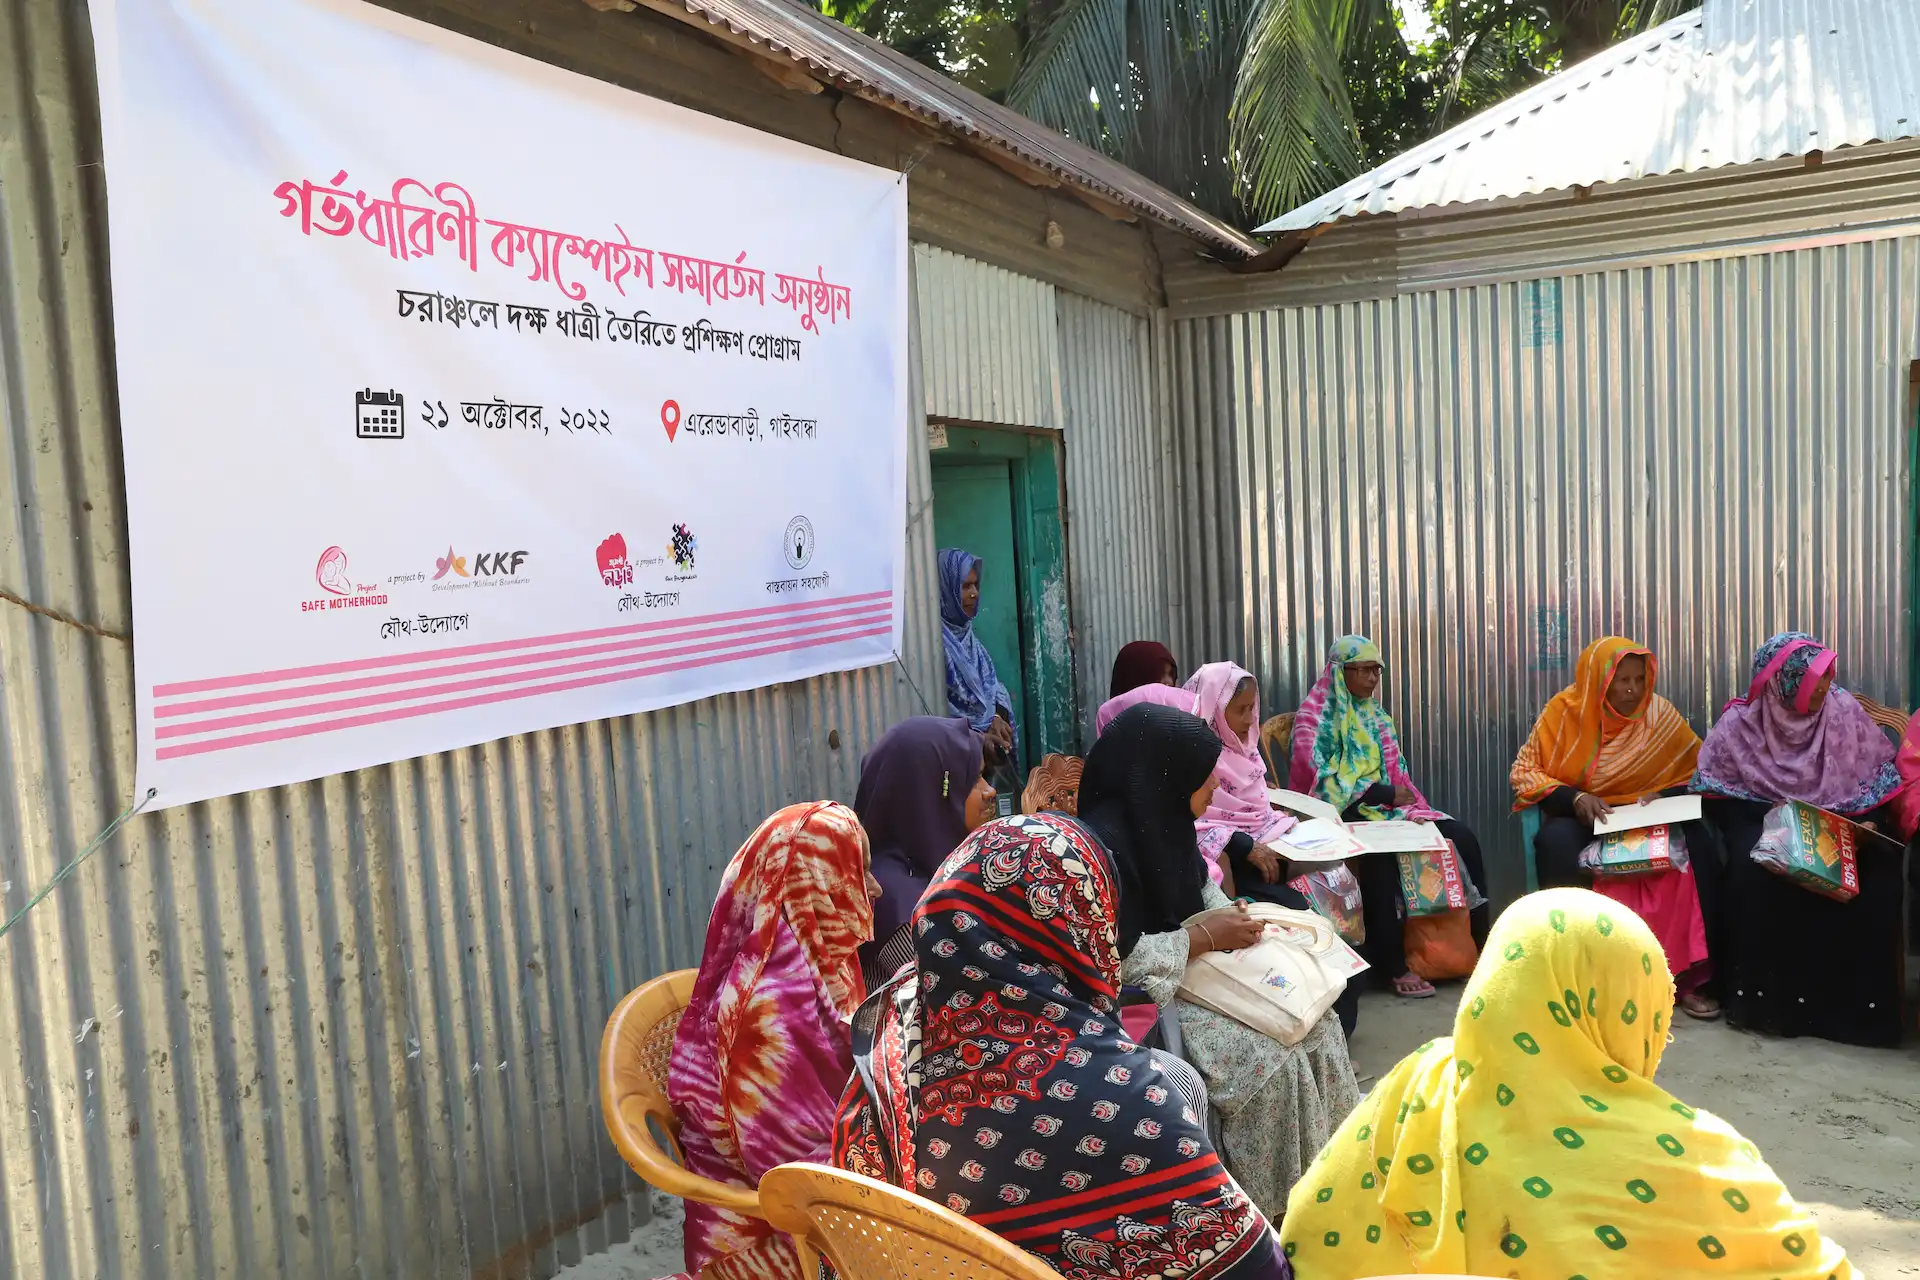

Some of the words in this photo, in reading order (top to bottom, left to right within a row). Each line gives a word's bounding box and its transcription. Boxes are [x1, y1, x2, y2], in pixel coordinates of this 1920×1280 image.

[273, 169, 480, 272] গর্ভধারিণী
[484, 219, 655, 305] ক্যাম্পেইন
[658, 250, 766, 306] সমাবর্তন
[771, 265, 852, 336] অনুষ্ঠান
[395, 289, 501, 330] চরাঞ্চলে
[505, 303, 550, 335] দক্ষ
[555, 301, 602, 342] ধাত্রী
[604, 305, 678, 347] তৈরিতে
[681, 318, 745, 356] প্রশিক্ষণ
[748, 333, 802, 362] প্রোগ্রাম
[421, 400, 449, 430] ২১
[459, 394, 549, 437] অক্টোবর,
[559, 406, 613, 436] ২০২২
[769, 410, 818, 440] গাইবান্ধা
[474, 550, 530, 577] KKF
[393, 571, 416, 585] project
[417, 571, 426, 582] by
[432, 581, 471, 594] Development
[472, 579, 498, 588] Without
[766, 579, 798, 594] বাস্তবায়ন
[801, 571, 830, 590] সহযোগী
[301, 599, 326, 612] SAFE
[329, 594, 388, 609] MOTHERHOOD
[617, 590, 680, 612] যৌথ-উদ্যোগে
[380, 612, 469, 640] যৌথ-উদ্যোগে
[1799, 808, 1815, 856] LEXUS
[1839, 821, 1853, 861] EXTRA
[1400, 854, 1418, 902] LEXUS
[1843, 863, 1856, 888] 50%
[1448, 884, 1462, 908] 50%
